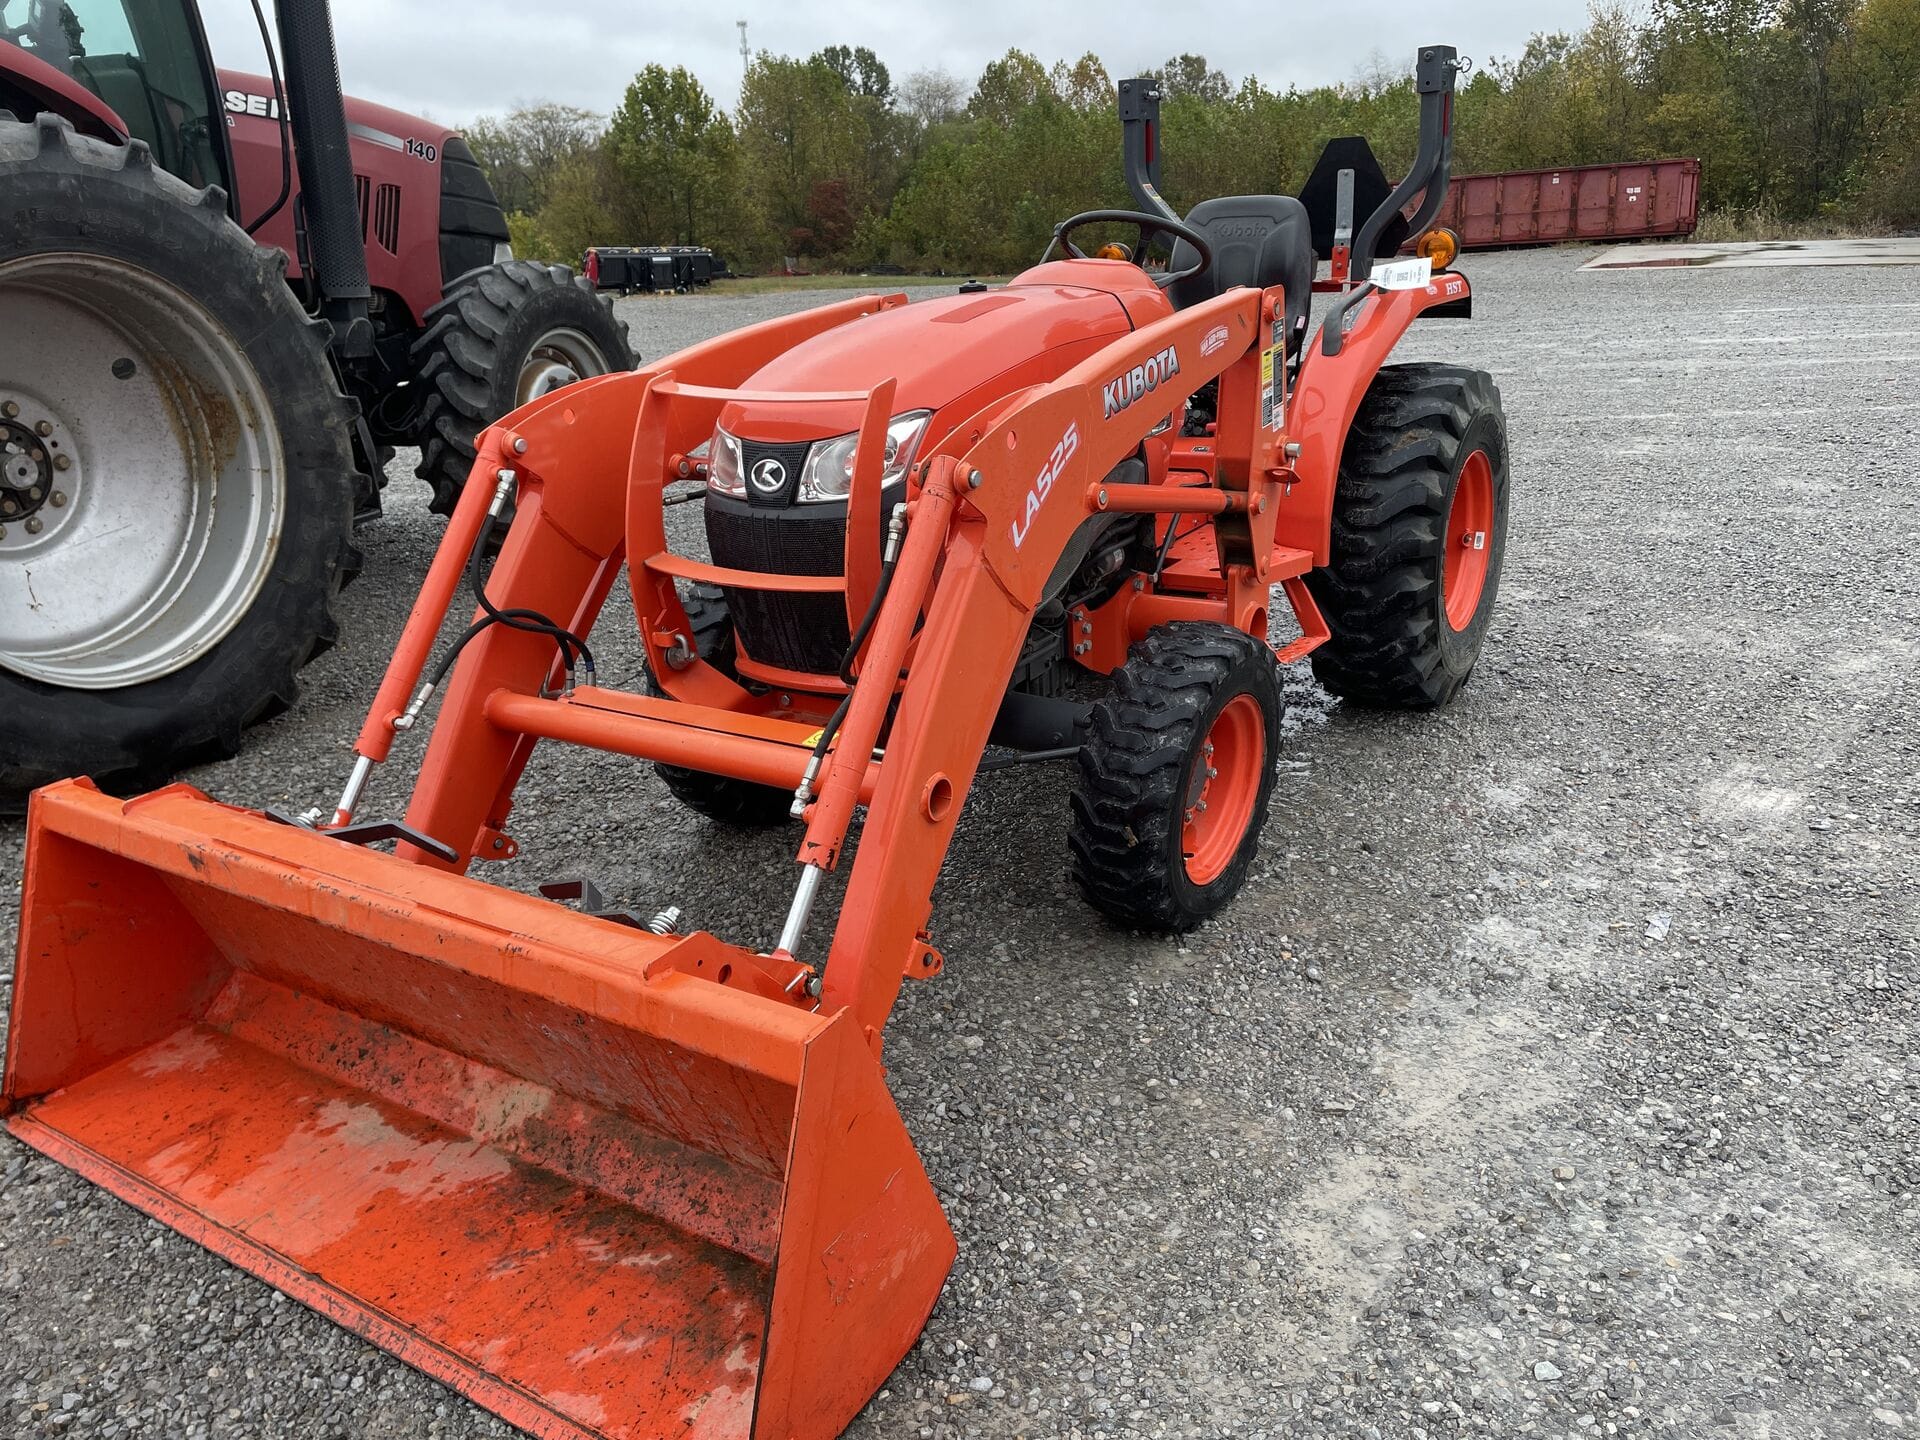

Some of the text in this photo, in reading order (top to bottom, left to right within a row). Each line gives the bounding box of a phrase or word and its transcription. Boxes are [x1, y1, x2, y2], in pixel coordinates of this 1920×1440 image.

[224, 90, 267, 117] SE
[405, 137, 438, 164] 140
[1445, 280, 1462, 296] HST
[1103, 344, 1181, 420] KUBOTA
[1011, 420, 1078, 549] LA525
